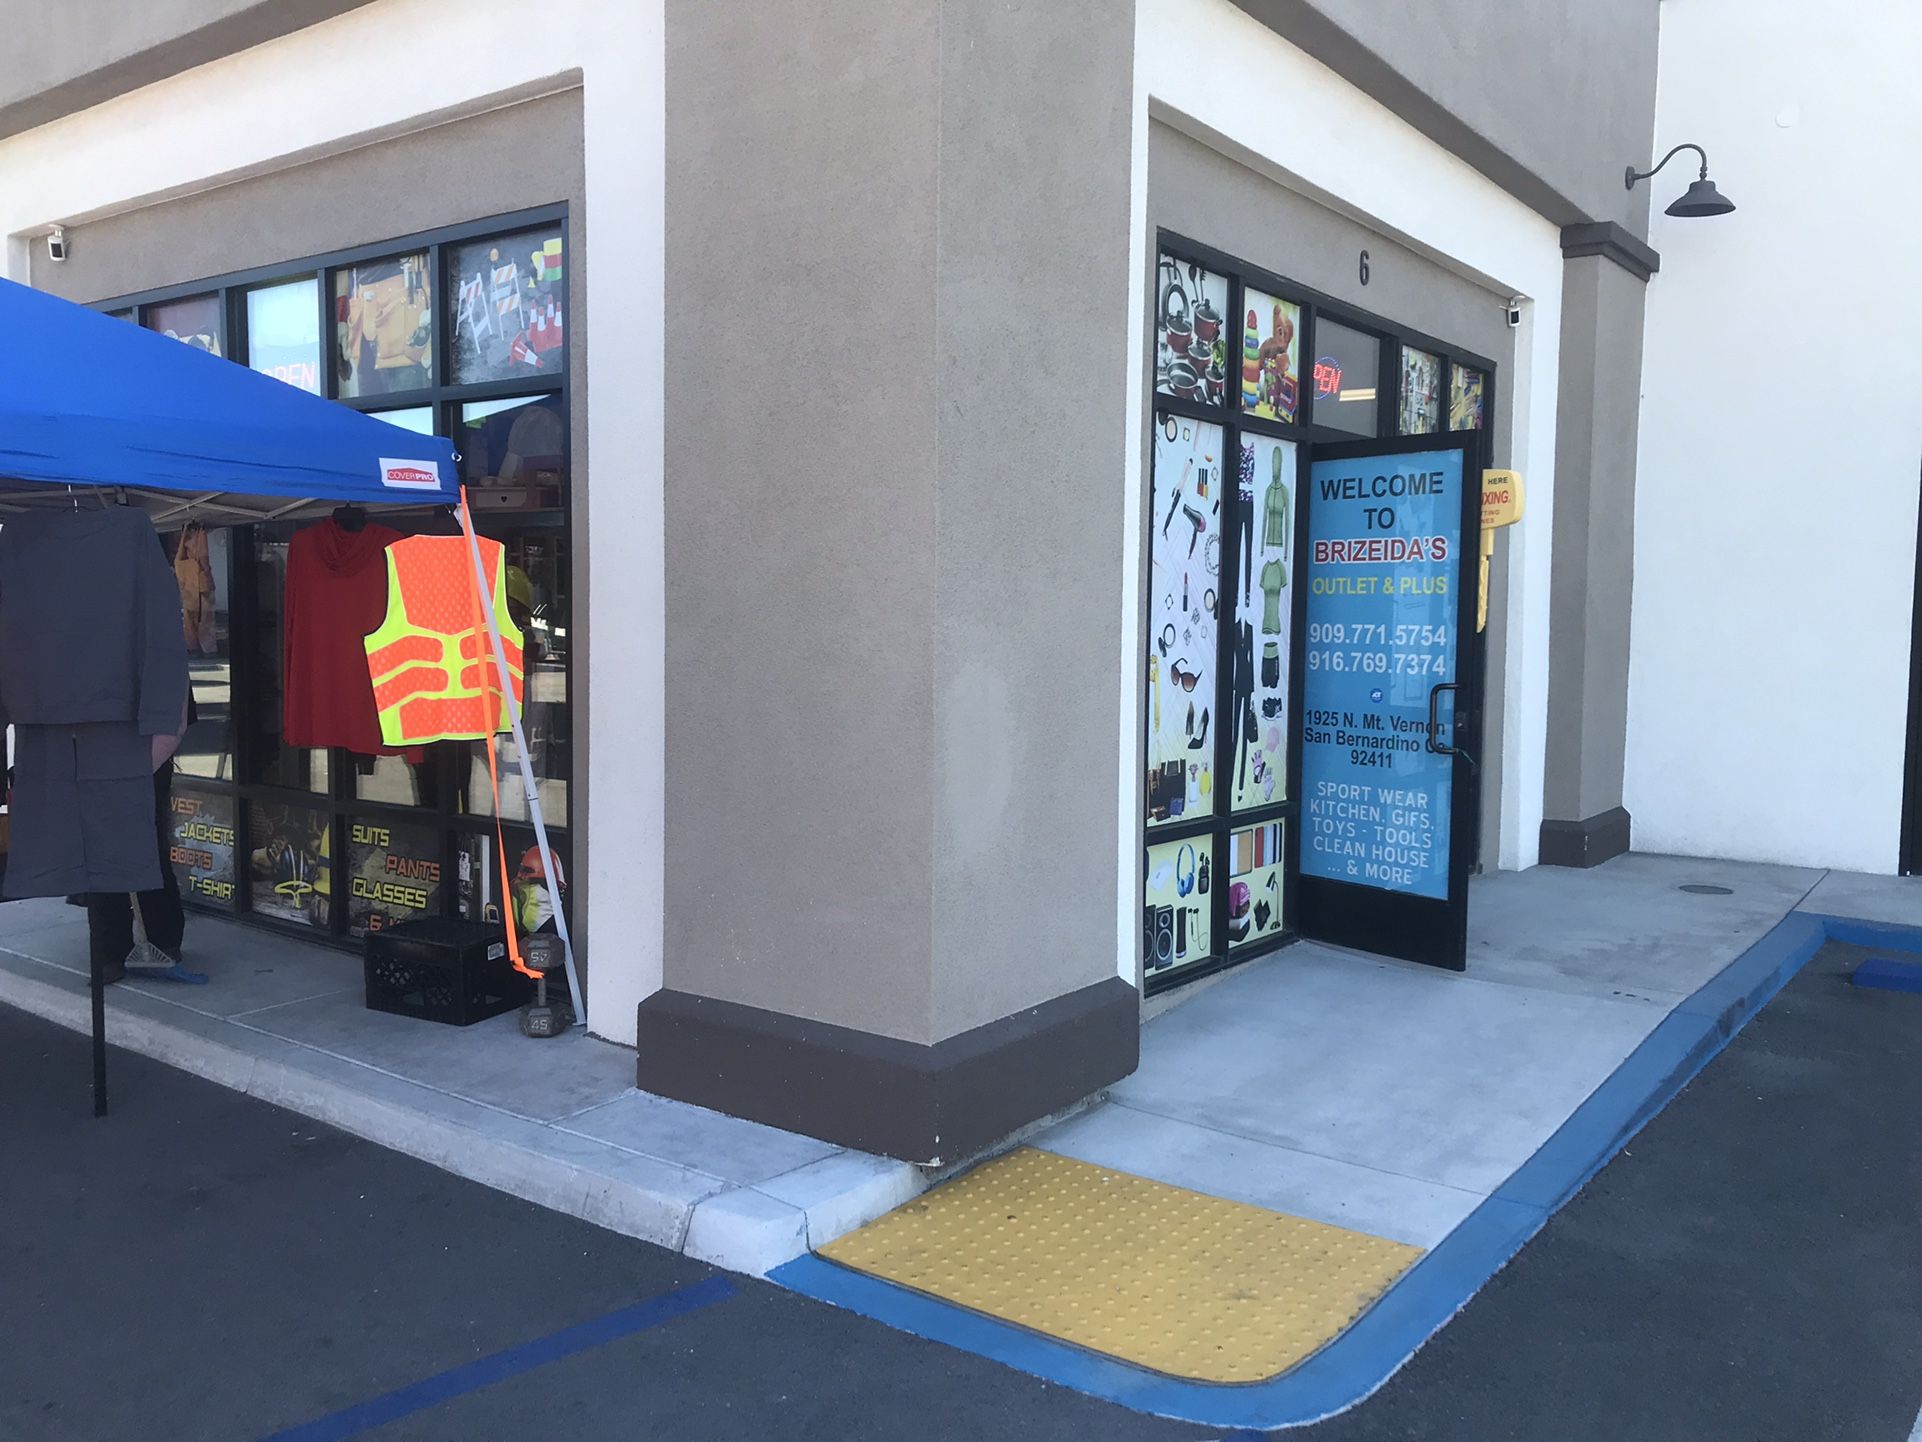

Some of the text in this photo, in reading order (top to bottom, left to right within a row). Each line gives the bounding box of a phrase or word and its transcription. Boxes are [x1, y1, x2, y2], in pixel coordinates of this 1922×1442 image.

[1360, 249, 1370, 286] 6
[1313, 364, 1342, 394] PEN
[388, 468, 434, 481] COVERPRO
[1320, 471, 1443, 501] WELCOME
[1487, 476, 1509, 485] HERE
[1363, 507, 1395, 530] TO
[1314, 536, 1447, 564] BRIZEIDA'S
[1312, 575, 1447, 595] OUTLET & PLUS
[1310, 622, 1447, 646] 909.771.5754
[1309, 650, 1446, 676] 916.769.7374
[1306, 709, 1339, 727] 1925
[1343, 712, 1358, 728] N.
[1363, 713, 1385, 731] Mt.
[1304, 727, 1331, 745] San
[1336, 729, 1420, 752] Bernardino
[1351, 749, 1392, 769] 92411
[170, 796, 203, 815] VEST
[1317, 781, 1428, 809] SPORT WEAR
[352, 825, 390, 847] SUITS
[1312, 817, 1356, 838] TOYS
[1374, 826, 1432, 849] TOOLS
[170, 847, 213, 870] BOOTS
[1313, 836, 1430, 868] CLEAN HOUSE
[386, 855, 440, 881] PANTS
[1347, 860, 1359, 876] &
[1365, 863, 1413, 885] MORE
[189, 876, 235, 899] T-SHIR
[352, 878, 427, 909] GLASSES
[531, 1019, 548, 1030] 45
